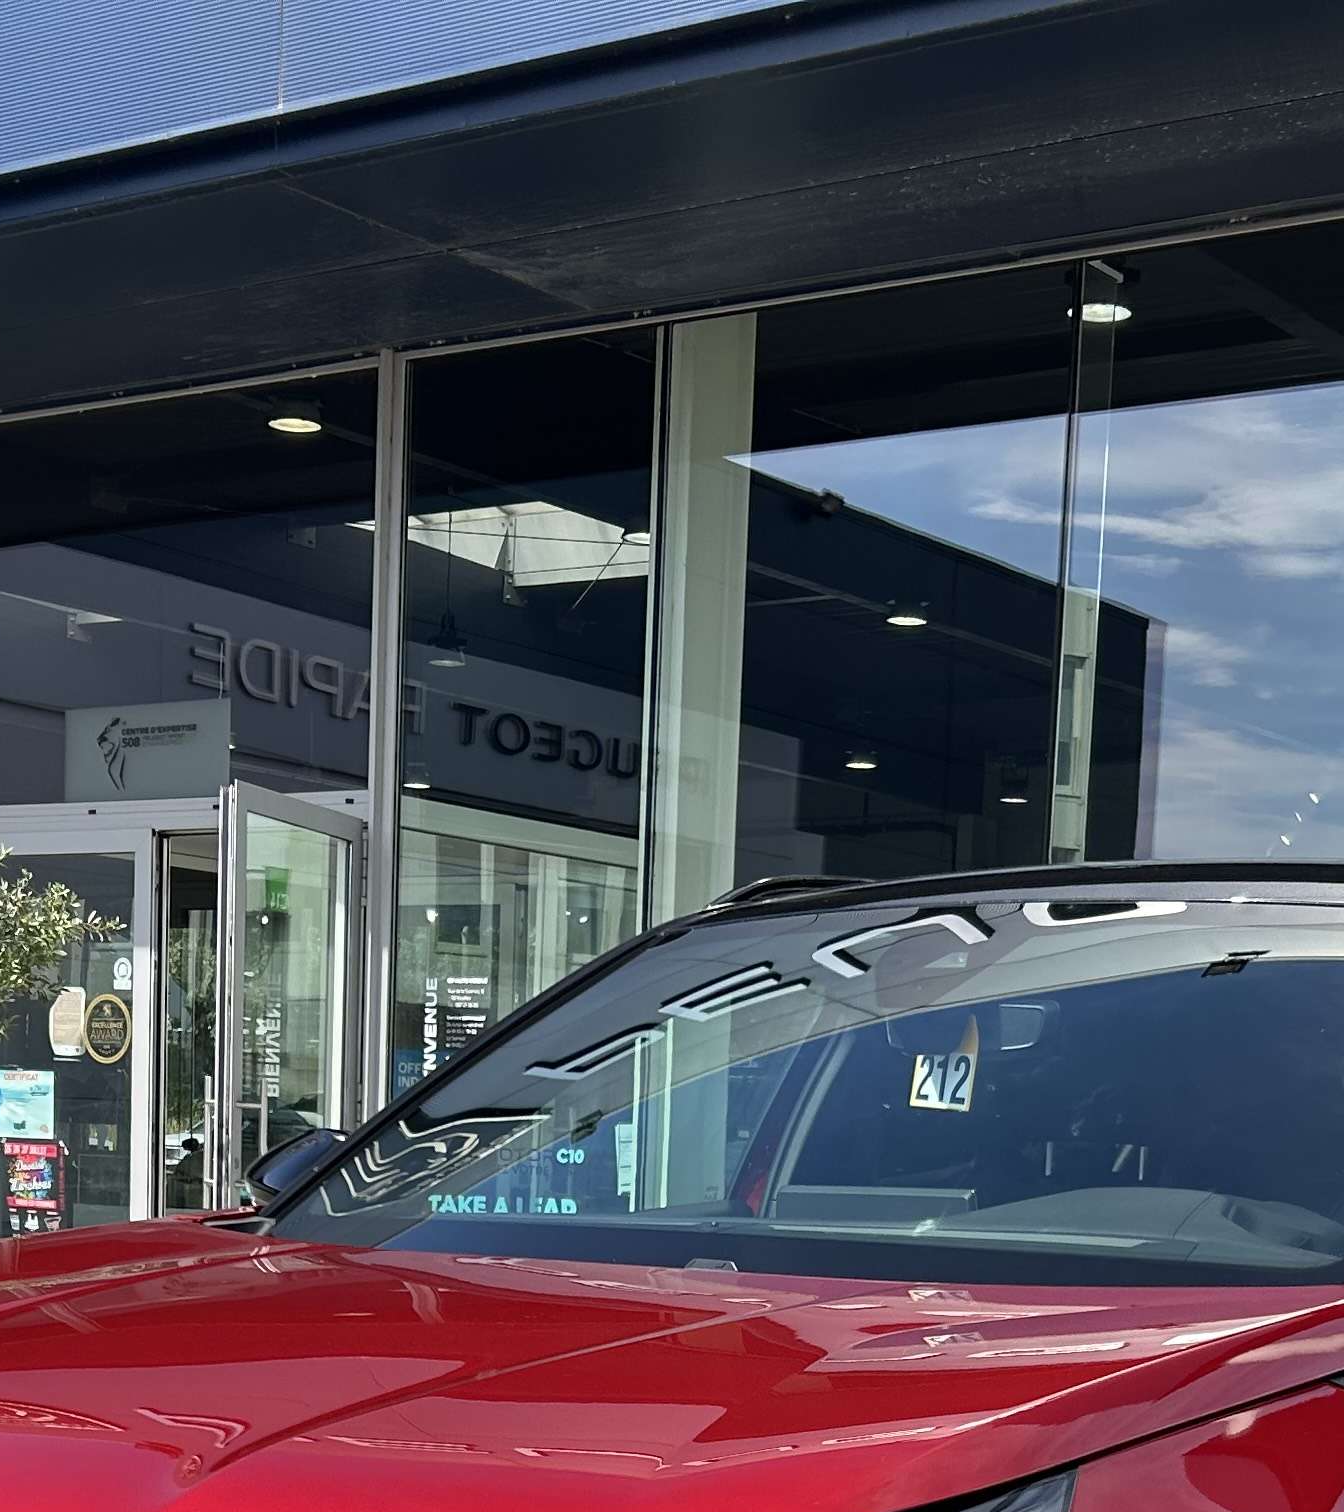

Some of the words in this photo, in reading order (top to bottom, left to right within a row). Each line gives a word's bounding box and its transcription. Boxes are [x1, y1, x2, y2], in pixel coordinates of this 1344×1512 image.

[90, 1028, 124, 1041] AWARD
[422, 977, 438, 1077] NVENUE
[915, 1054, 971, 1105] 212
[428, 1194, 487, 1214] TAKE
[493, 1197, 509, 1213] A
